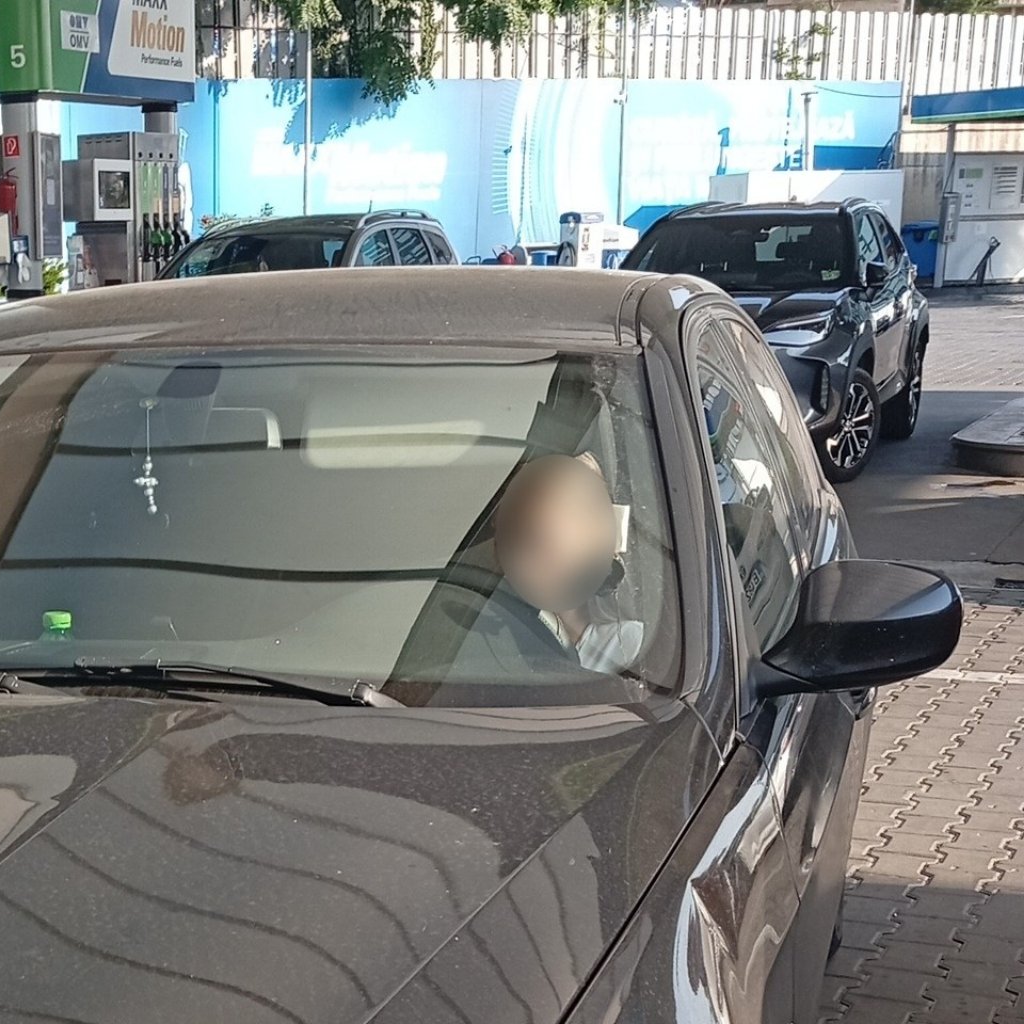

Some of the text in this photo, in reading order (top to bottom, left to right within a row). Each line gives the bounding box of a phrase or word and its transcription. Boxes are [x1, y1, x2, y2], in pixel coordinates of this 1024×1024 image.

[130, 10, 185, 53] Motion
[70, 34, 90, 49] OMV
[10, 44, 26, 68] 5
[141, 53, 170, 66] Performance
